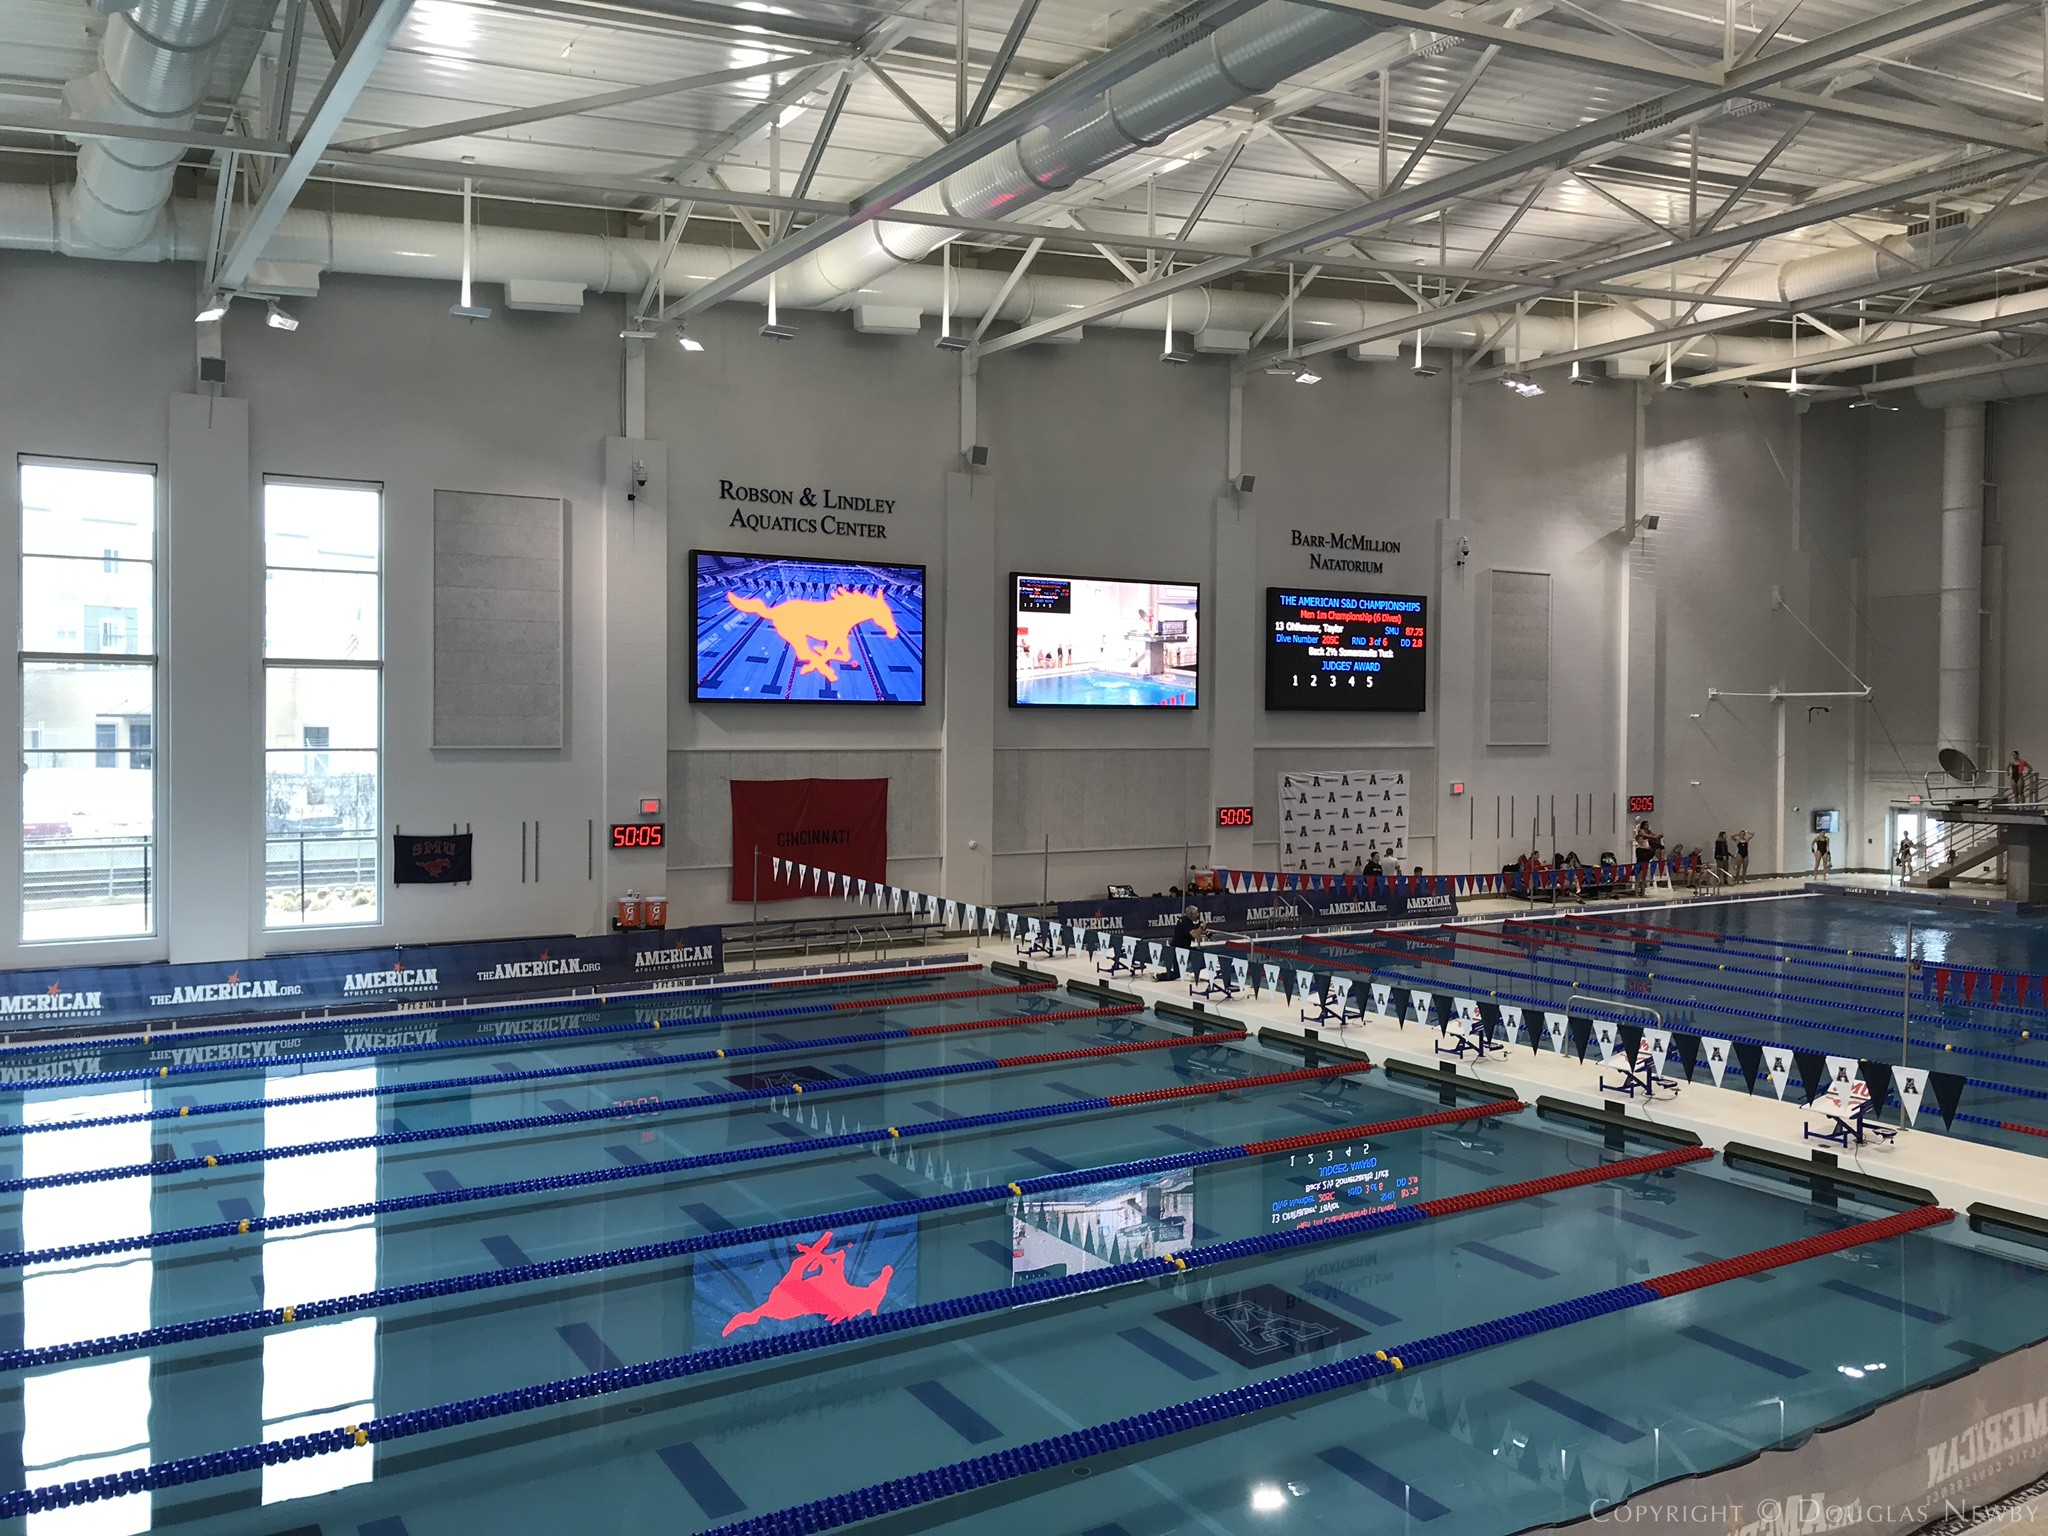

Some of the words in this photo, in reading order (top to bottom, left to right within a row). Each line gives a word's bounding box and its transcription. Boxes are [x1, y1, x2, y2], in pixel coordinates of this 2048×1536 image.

[719, 479, 793, 505] ROBSON
[799, 487, 817, 507] &
[824, 489, 895, 513] LINDLEY
[729, 508, 817, 533] AQUATICS
[821, 515, 887, 539] CENTER
[1309, 553, 1383, 574] NATATORIUM
[1280, 595, 1297, 606] THE
[1298, 596, 1339, 608] AMERICAN
[1341, 598, 1357, 609] S&D
[1359, 599, 1420, 612] CHAMPIONSHIPS
[1300, 610, 1315, 619] Men
[1328, 610, 1373, 622] Championship
[1382, 613, 1401, 624] Dives)
[1275, 622, 1284, 631] 13
[1385, 626, 1399, 636] SMU
[1276, 634, 1291, 643] Dive
[1293, 635, 1319, 644] Number
[1352, 637, 1366, 646] RND
[1374, 637, 1381, 646] of
[1382, 638, 1388, 647] 6
[1400, 639, 1411, 647] DD
[1353, 662, 1381, 672] AWARD
[1292, 675, 1298, 686] 1
[1310, 675, 1317, 687] 2
[1329, 675, 1336, 687] 3
[1348, 675, 1355, 687] 4
[1366, 676, 1373, 688] 5
[1220, 809, 1251, 825] 50:05
[614, 826, 661, 847] 50:05
[777, 829, 850, 847] CINCINNATI
[411, 840, 457, 857] SMU
[1406, 894, 1451, 909] AMERICAN
[1066, 917, 1124, 930] AMERICAN
[635, 946, 713, 968] AMERICAN
[343, 968, 438, 991] AMERICAN
[343, 988, 385, 997] ATHLETIC
[387, 985, 438, 994] CONFERENCE
[0, 992, 101, 1014] MERICAN
[38, 1010, 101, 1019] CONFERENCE
